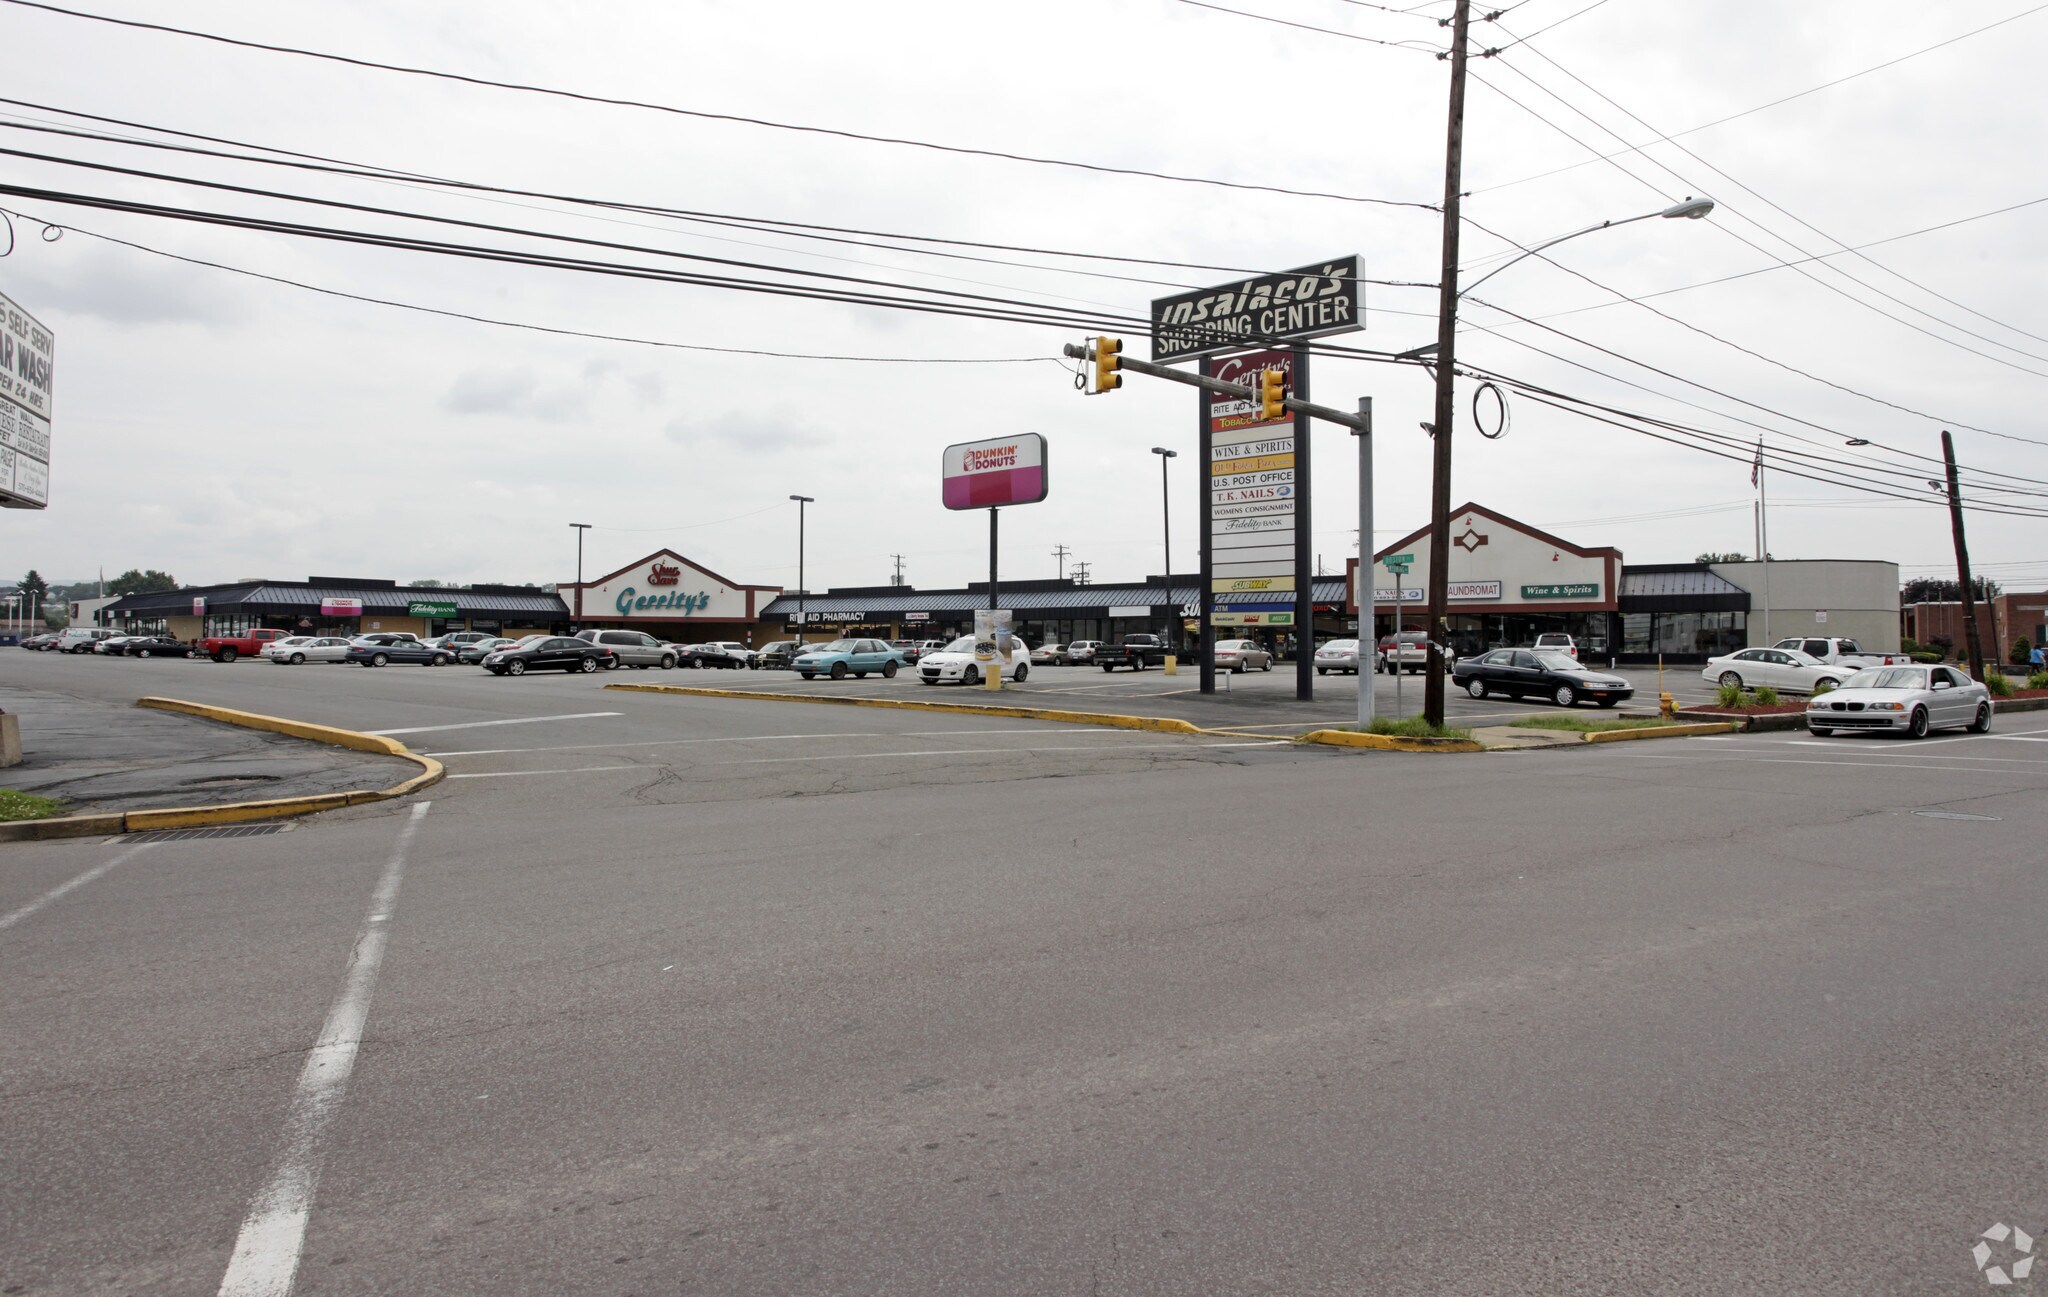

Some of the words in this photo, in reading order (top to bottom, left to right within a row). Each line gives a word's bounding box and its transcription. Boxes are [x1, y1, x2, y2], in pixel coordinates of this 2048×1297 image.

[8, 309, 29, 340] SELF
[1158, 314, 1252, 354] SHOPPING
[1260, 295, 1349, 335] CENTER
[18, 341, 51, 396] WASH
[15, 383, 27, 399] 24
[1213, 405, 1229, 414] RITE
[975, 445, 1018, 459] DUNKIN'
[1215, 446, 1240, 458] WINE
[1243, 445, 1251, 455] &
[1255, 440, 1292, 453] SPIRITS
[975, 456, 1015, 470] DONUTS
[1213, 478, 1230, 487] U.S.
[1233, 475, 1256, 485] POST
[1260, 471, 1292, 482] OFFICE
[1241, 488, 1274, 499] NAILS
[1214, 507, 1242, 515] WOMENS
[1245, 503, 1293, 513] CONSIGNMENT
[1225, 518, 1261, 531] Fidelity
[1262, 519, 1282, 527] BANK
[1231, 579, 1272, 591] SUBWAY
[1448, 584, 1498, 596] AUNDROMAT
[1526, 587, 1548, 595] Wine
[1551, 586, 1560, 594] &
[1562, 585, 1592, 596] Spirits
[410, 603, 437, 614] Fidelity
[615, 587, 711, 617] Gerrity's
[807, 613, 820, 622] AID
[822, 612, 866, 621] PHARMACY
